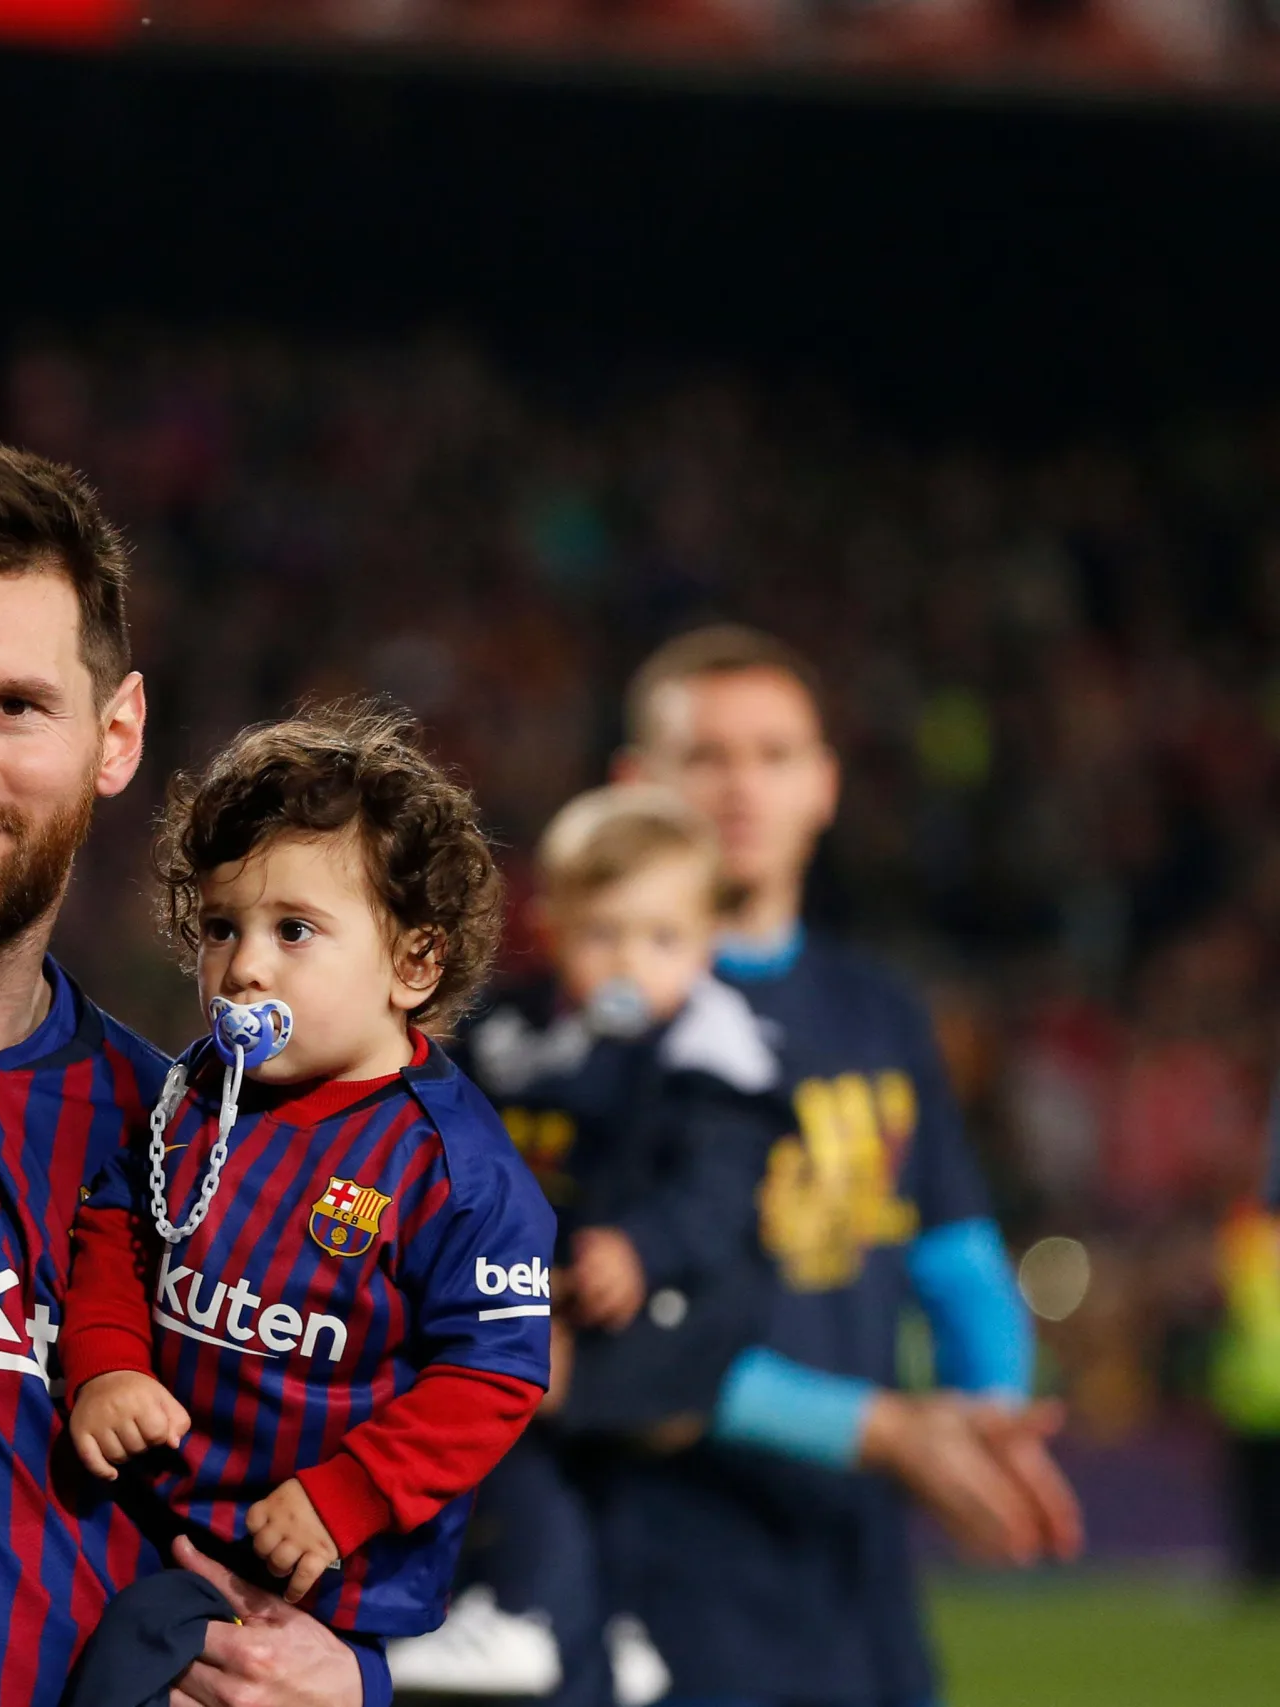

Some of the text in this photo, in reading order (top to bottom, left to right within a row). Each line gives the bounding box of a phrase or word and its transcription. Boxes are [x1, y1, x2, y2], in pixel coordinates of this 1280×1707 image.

[332, 1208, 360, 1226] FCB
[475, 1256, 551, 1299] bek
[156, 1243, 348, 1363] kuten
